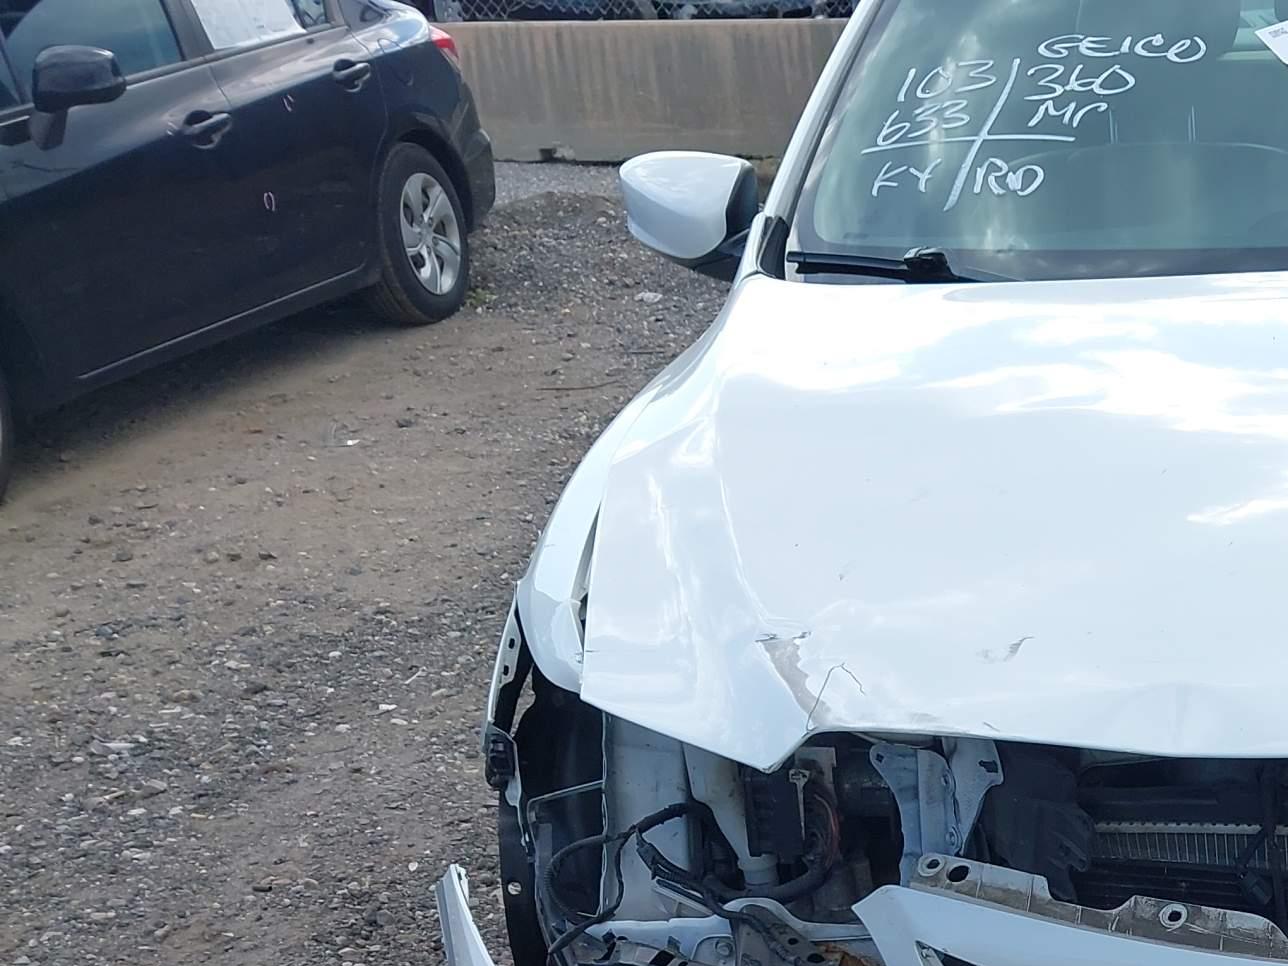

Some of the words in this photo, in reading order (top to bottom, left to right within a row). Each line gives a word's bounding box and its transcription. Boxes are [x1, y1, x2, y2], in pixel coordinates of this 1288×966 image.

[1038, 34, 1207, 62] GEICO
[897, 60, 997, 102] 103
[1024, 64, 1136, 100] 360
[877, 99, 970, 146] 633
